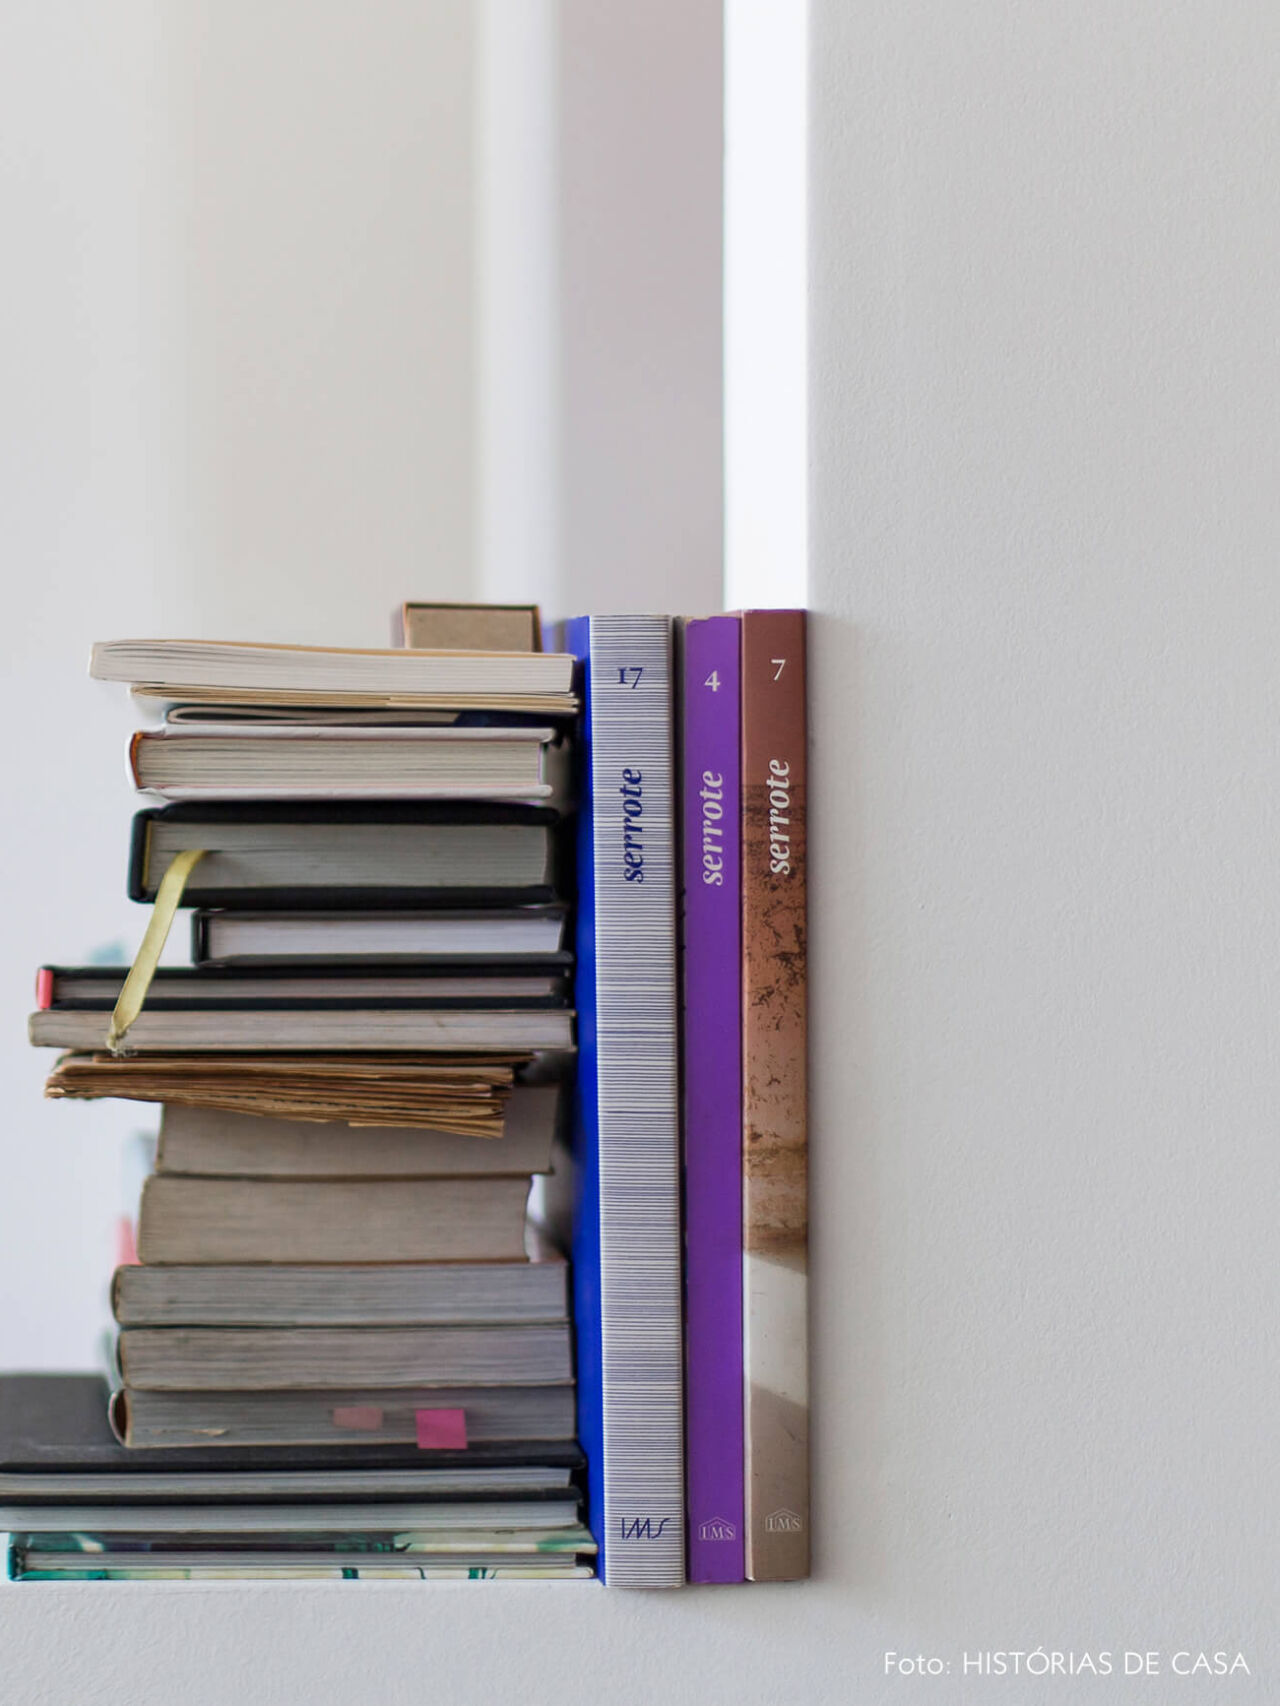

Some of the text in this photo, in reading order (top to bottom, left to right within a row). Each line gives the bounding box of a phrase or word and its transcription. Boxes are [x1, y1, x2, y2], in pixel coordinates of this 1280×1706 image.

[617, 666, 644, 690] 17
[704, 670, 721, 692] 4
[770, 658, 786, 681] 7
[620, 767, 644, 883] serrote
[699, 770, 723, 886] serrote
[766, 759, 790, 875] serrote
[621, 1517, 670, 1540] IMS
[701, 1526, 735, 1539] IMS
[768, 1517, 801, 1530] IMS
